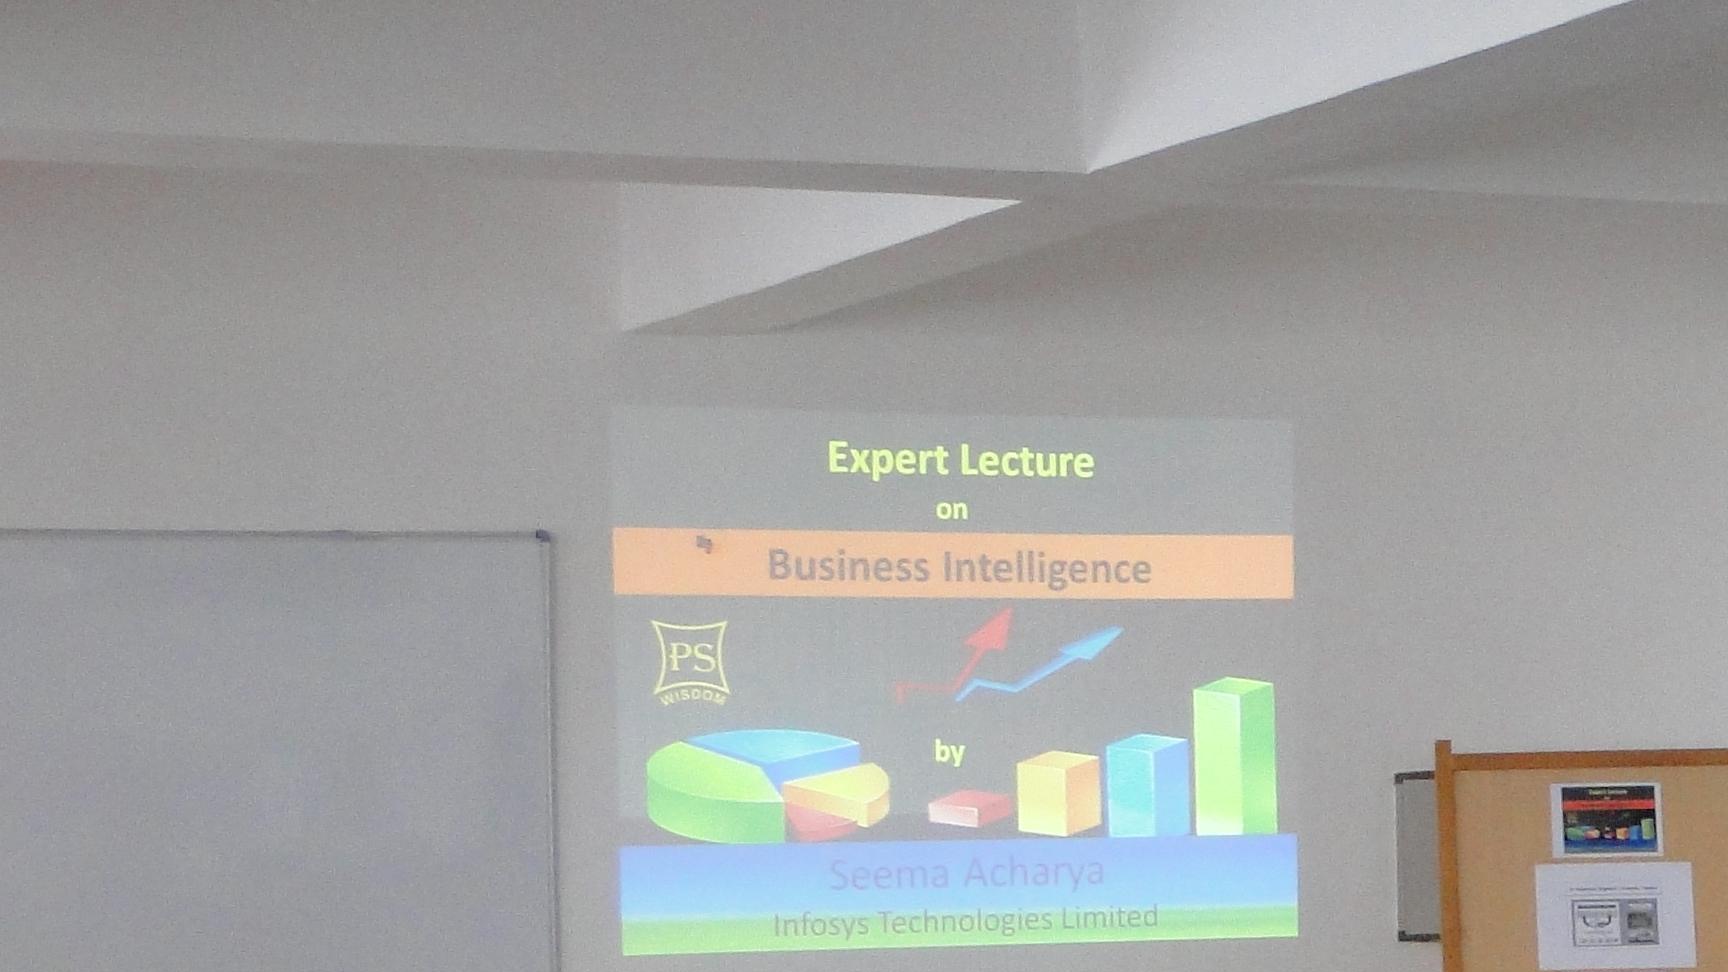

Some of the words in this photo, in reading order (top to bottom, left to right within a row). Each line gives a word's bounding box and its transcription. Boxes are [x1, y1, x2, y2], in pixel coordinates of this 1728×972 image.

[828, 440, 949, 482] Expert
[960, 443, 1095, 478] Lecture
[936, 501, 968, 520] on
[768, 548, 930, 582] Business
[944, 550, 1151, 591] Intelligence
[669, 642, 716, 672] PS
[660, 688, 726, 705] WISDOM
[934, 738, 966, 768] by
[829, 858, 949, 890] Seema
[963, 854, 1104, 893] Acharya
[773, 909, 870, 941] Infosys
[877, 907, 1053, 936] Technologies
[1061, 904, 1159, 931] Limited
